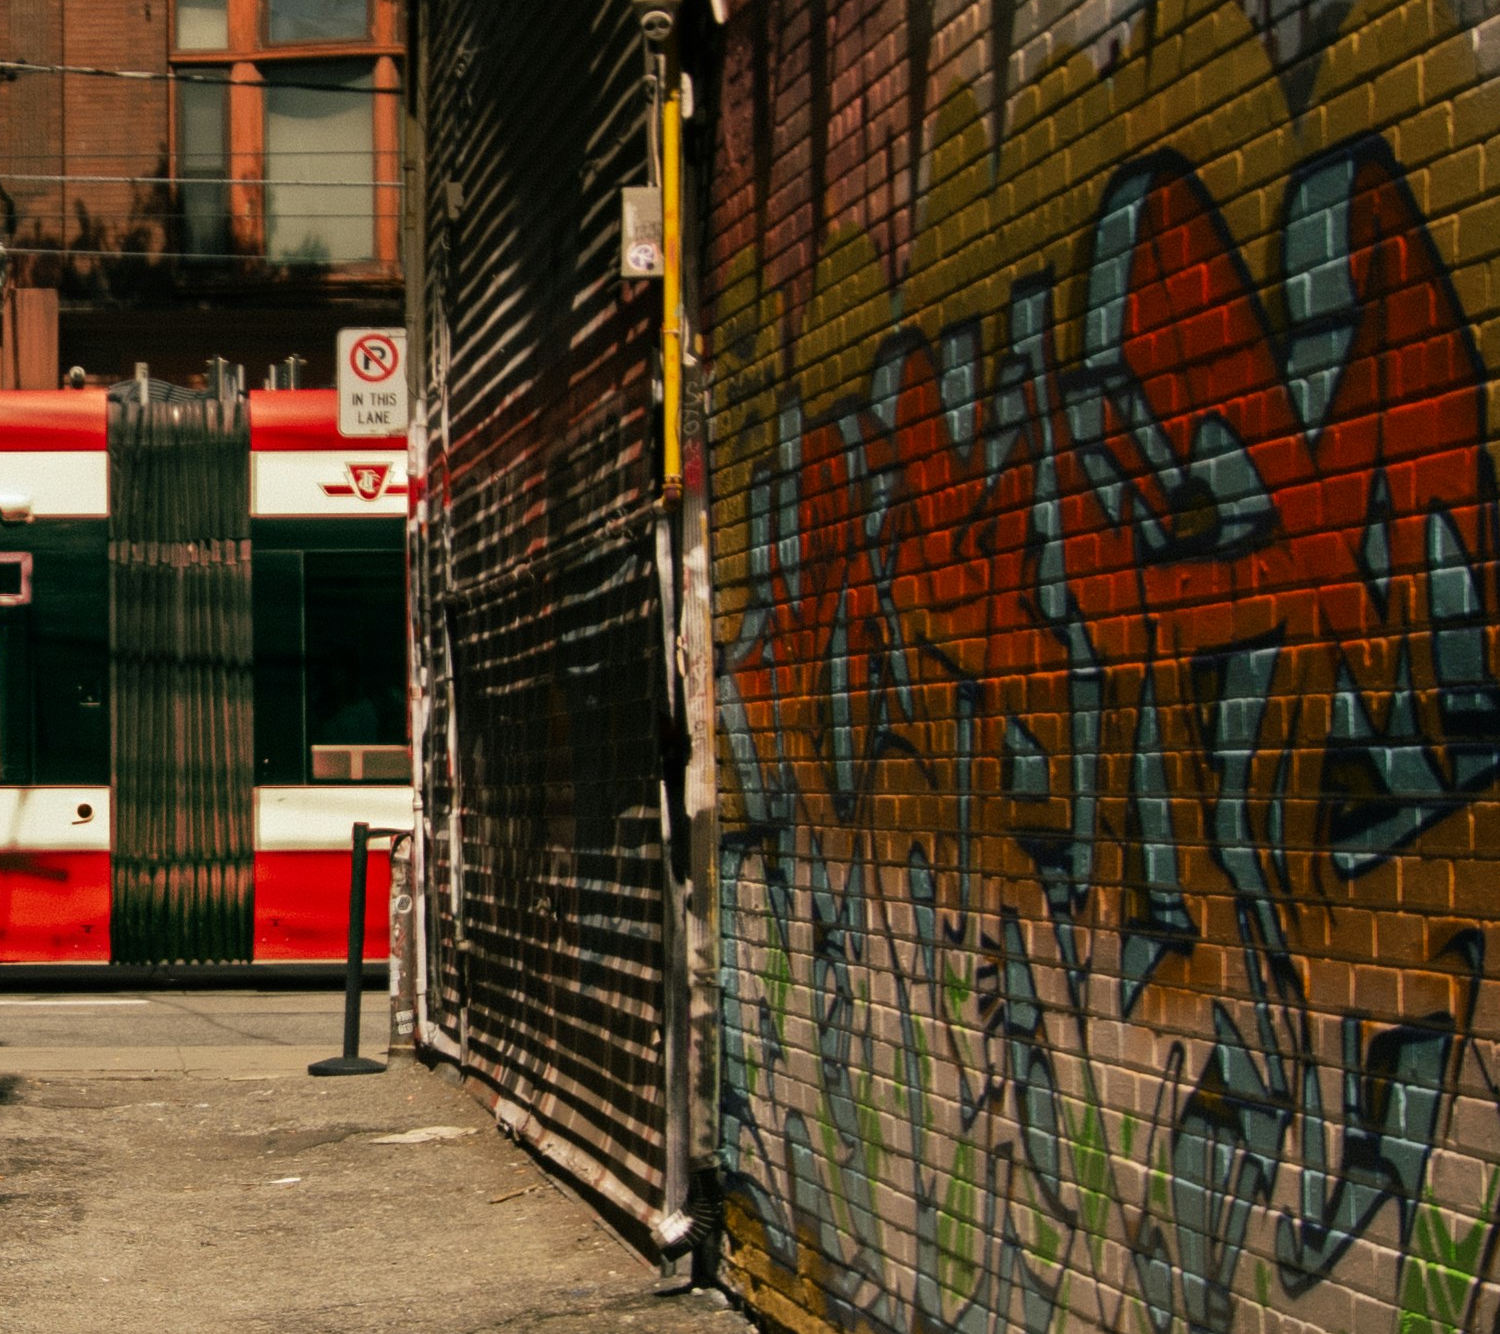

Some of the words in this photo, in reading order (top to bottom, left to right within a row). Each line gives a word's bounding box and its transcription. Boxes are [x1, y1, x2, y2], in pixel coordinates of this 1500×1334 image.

[351, 392, 364, 406] IN
[370, 392, 397, 406] THIS
[357, 411, 391, 424] LANE
